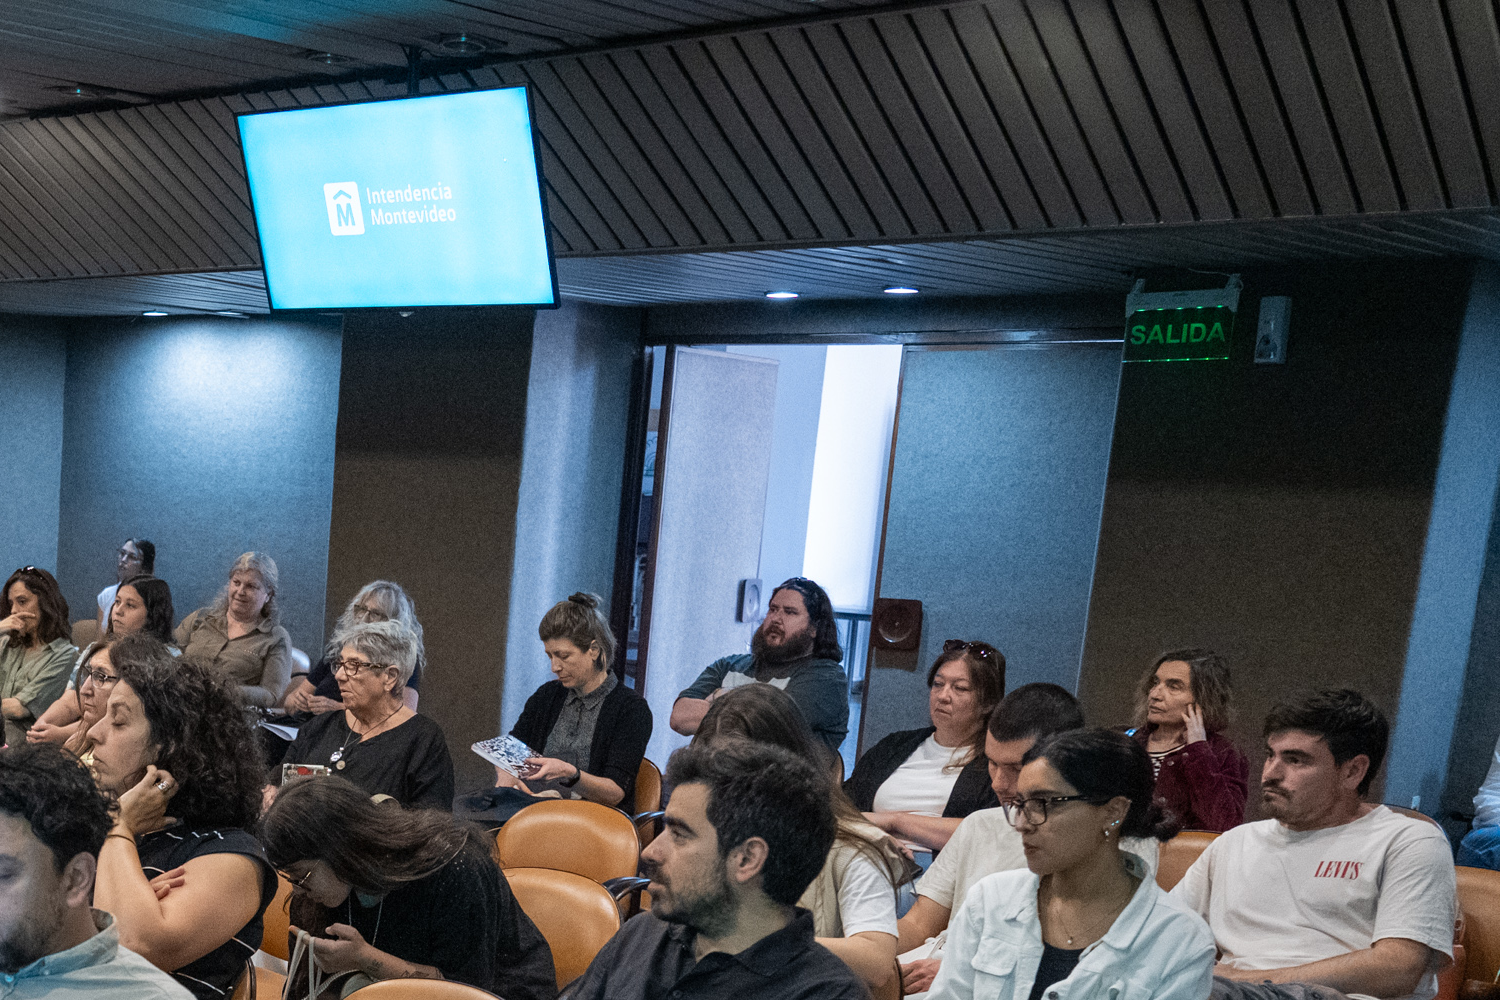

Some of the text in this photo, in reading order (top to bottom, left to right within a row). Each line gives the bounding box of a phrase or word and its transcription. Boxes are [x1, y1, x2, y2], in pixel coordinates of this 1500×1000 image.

[366, 182, 453, 205] Intendencia
[370, 204, 457, 226] Montevideo
[1130, 322, 1226, 345] SALIDA
[1313, 860, 1365, 881] LEVI'S
